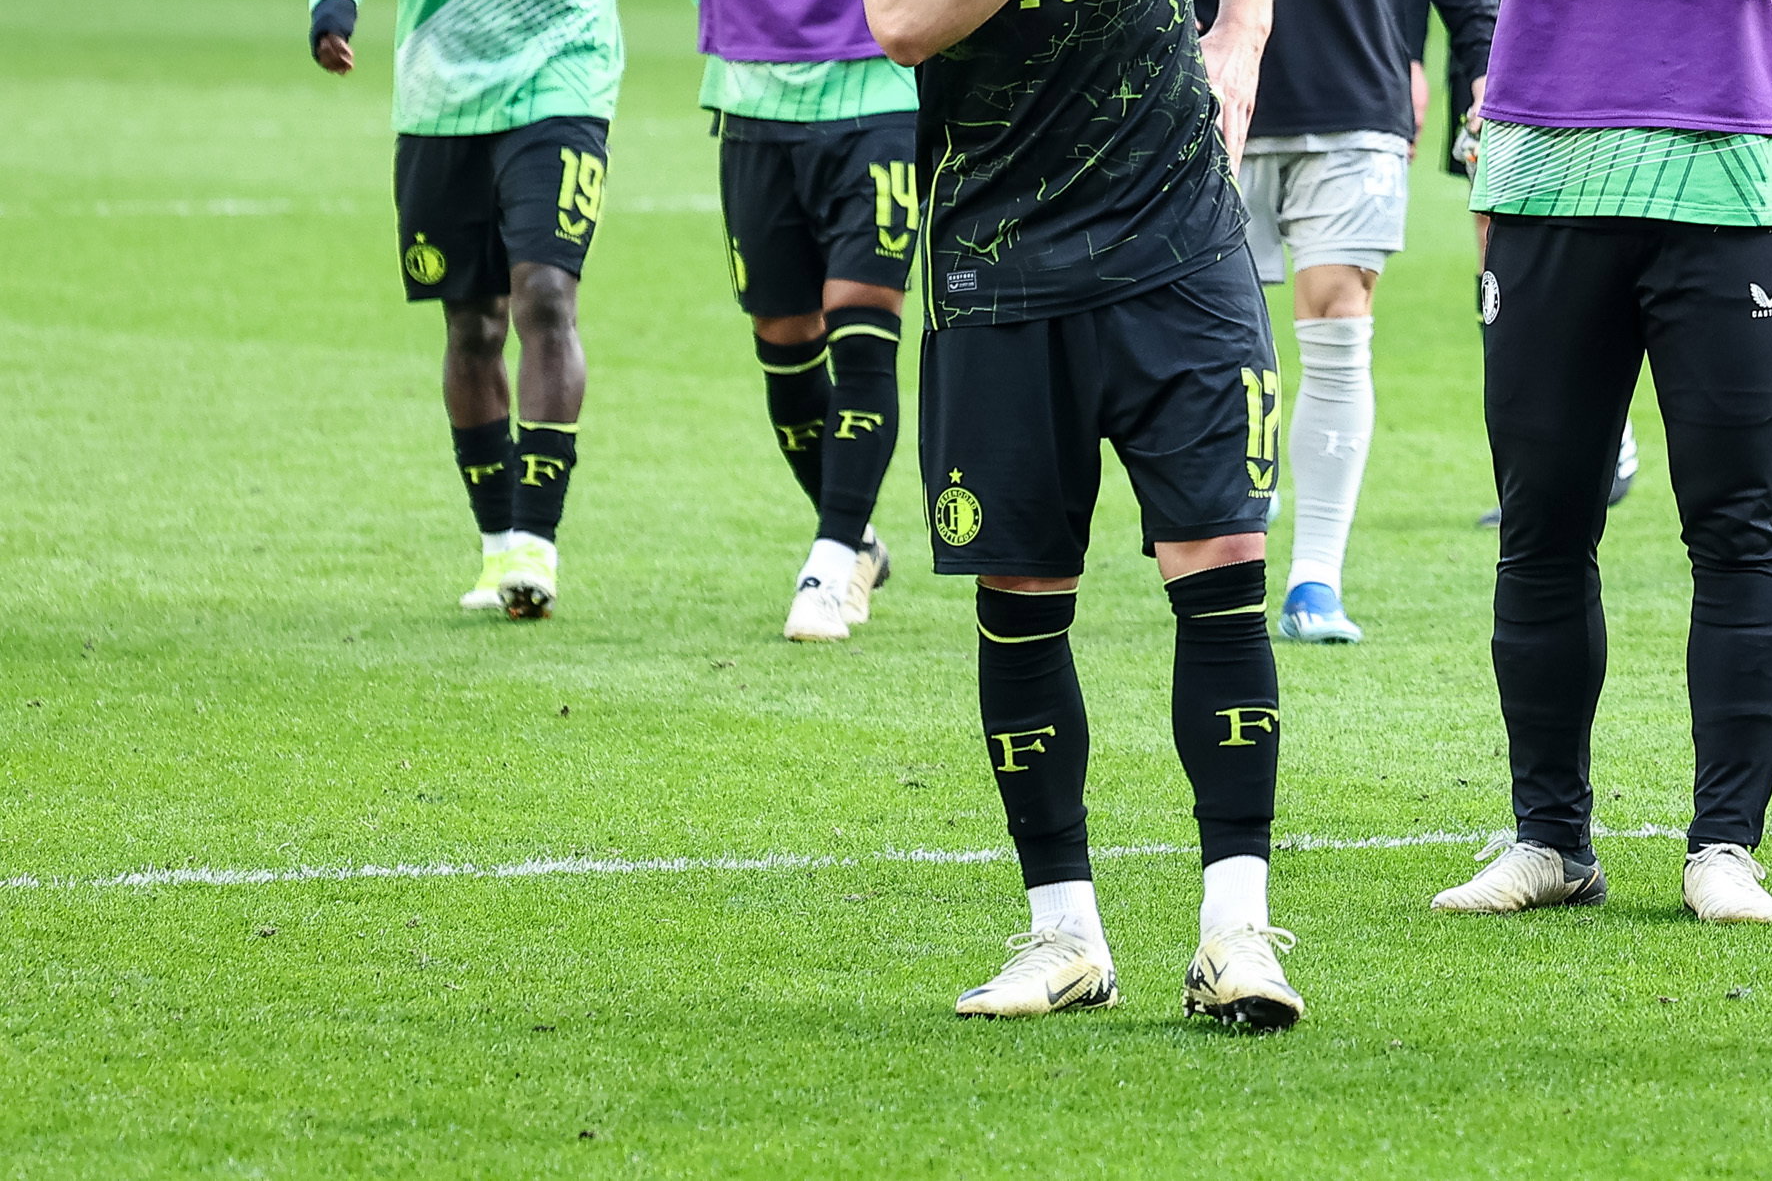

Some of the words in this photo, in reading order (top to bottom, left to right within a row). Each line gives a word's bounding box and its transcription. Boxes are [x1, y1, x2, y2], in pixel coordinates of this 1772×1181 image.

[558, 146, 605, 223] 19
[869, 160, 920, 231] 14
[834, 409, 885, 439] F
[520, 453, 566, 488] F
[991, 724, 1056, 773] F
[1215, 707, 1280, 747] F
